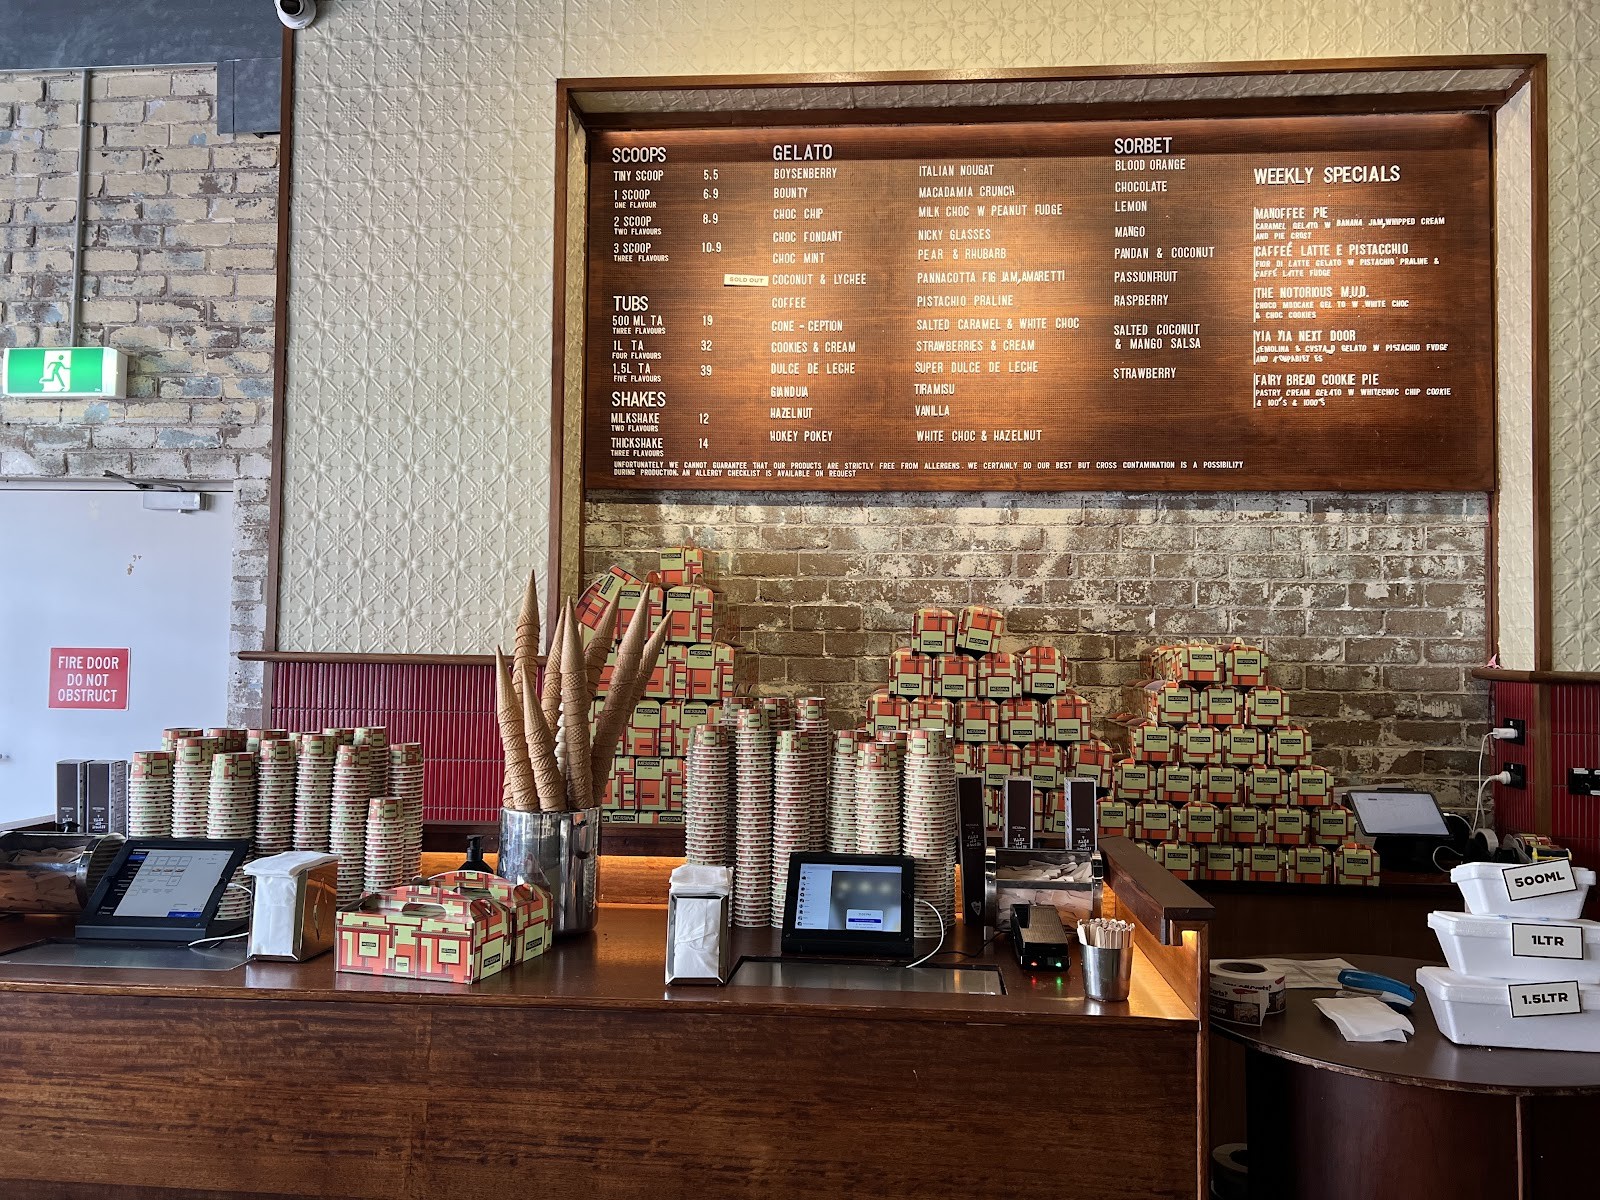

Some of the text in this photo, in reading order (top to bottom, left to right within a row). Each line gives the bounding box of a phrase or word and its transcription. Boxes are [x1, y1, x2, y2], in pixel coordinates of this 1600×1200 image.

[1114, 137, 1172, 154] SORBET
[612, 147, 667, 163] SCOOPS
[773, 143, 833, 161] GELATO
[919, 164, 994, 176] ITALIAN NOUGAT
[1115, 159, 1186, 171] BLOOD ORANGE
[613, 170, 664, 181] TINY SCOOP
[703, 169, 719, 181] 5.5
[774, 168, 837, 179] BOYSENBERRY
[1254, 165, 1400, 184] WEEKLY SPECIALS
[773, 187, 808, 198] BOUNTY
[919, 185, 1015, 198] MACADAMIA CRUNCH
[1115, 181, 1167, 193] CHOCOLATE
[614, 189, 650, 200] 1 SCOOP
[703, 188, 719, 199] 6.9
[918, 204, 1063, 218] MILK CHOC W PEANUT FUDGE
[1115, 201, 1147, 213] LEMON
[1256, 206, 1328, 219] MANOFFEE PIE
[703, 213, 718, 224] 8.9
[773, 208, 824, 219] CHOC CHIP
[614, 216, 652, 227] 2 SCOOP
[773, 231, 843, 243] CHOC FONDANT
[918, 229, 991, 241] NICKY GLASSES
[1115, 226, 1145, 238] MANGO
[614, 243, 651, 253] 3 SCOOP
[702, 242, 721, 253] 10.9
[1114, 247, 1214, 259] PANDAN & COCONUT
[1301, 244, 1330, 256] LATTE
[1336, 244, 1342, 256] E
[1349, 243, 1409, 255] PISTACCHIO
[918, 248, 1006, 260] PEAR & RHUBARB
[1348, 258, 1354, 266] W
[1360, 257, 1395, 265] PISTACHIO
[772, 273, 867, 285] COCONUT & LYCHEE
[1114, 271, 1178, 283] PASSIONFRUIT
[1256, 287, 1273, 299] THE
[1280, 286, 1333, 298] NOTORIOUS
[613, 296, 649, 311] TUBS
[772, 298, 807, 309] COFFEE
[917, 295, 1013, 307] PISTACHIO PRALINE
[1114, 294, 1169, 306] RASPBERRY
[613, 315, 663, 326] 500 ML TA
[703, 315, 713, 325] 19
[916, 317, 1079, 331] SALTED CARAMEL & WHITE CHOC
[1114, 324, 1200, 336] SALTED COCONUT
[1256, 330, 1271, 342] YIA
[1299, 330, 1322, 341] NEXT
[1330, 330, 1356, 341] DOOR
[701, 340, 712, 351] 32
[771, 342, 856, 353] COOKIES & CREAM
[1115, 337, 1201, 349] & MANGO SALSA
[613, 363, 650, 374] 1.5L TA
[700, 365, 712, 376] 39
[771, 363, 855, 375] DULCE DE LECHE
[1113, 367, 1176, 379] STRAWBERRY
[1256, 374, 1379, 386] FAIRY BREAD COOKIE PIE
[914, 383, 955, 395] TIRAMISU
[611, 391, 666, 407] SHAKES
[770, 408, 813, 419] HAZELNUT
[915, 405, 950, 417] VANILLA
[611, 413, 660, 423] MILKSHAKE
[699, 413, 709, 424] 12
[770, 431, 833, 442] HOKEY POKEY
[611, 438, 663, 448] THICKSHAKE
[699, 438, 708, 449] 14
[1123, 461, 1175, 469] CONTAMINATION
[766, 469, 772, 477] IS
[777, 469, 810, 477] AVAILABLE
[829, 469, 856, 477] REQUEST
[58, 656, 119, 669] FIRE DOOR
[67, 674, 109, 686] DO NOT
[58, 689, 117, 702] OBSTRUCT
[1515, 871, 1565, 888] 500ML
[1532, 935, 1564, 946] 1LTR
[1522, 992, 1568, 1005] 1.5LTR
